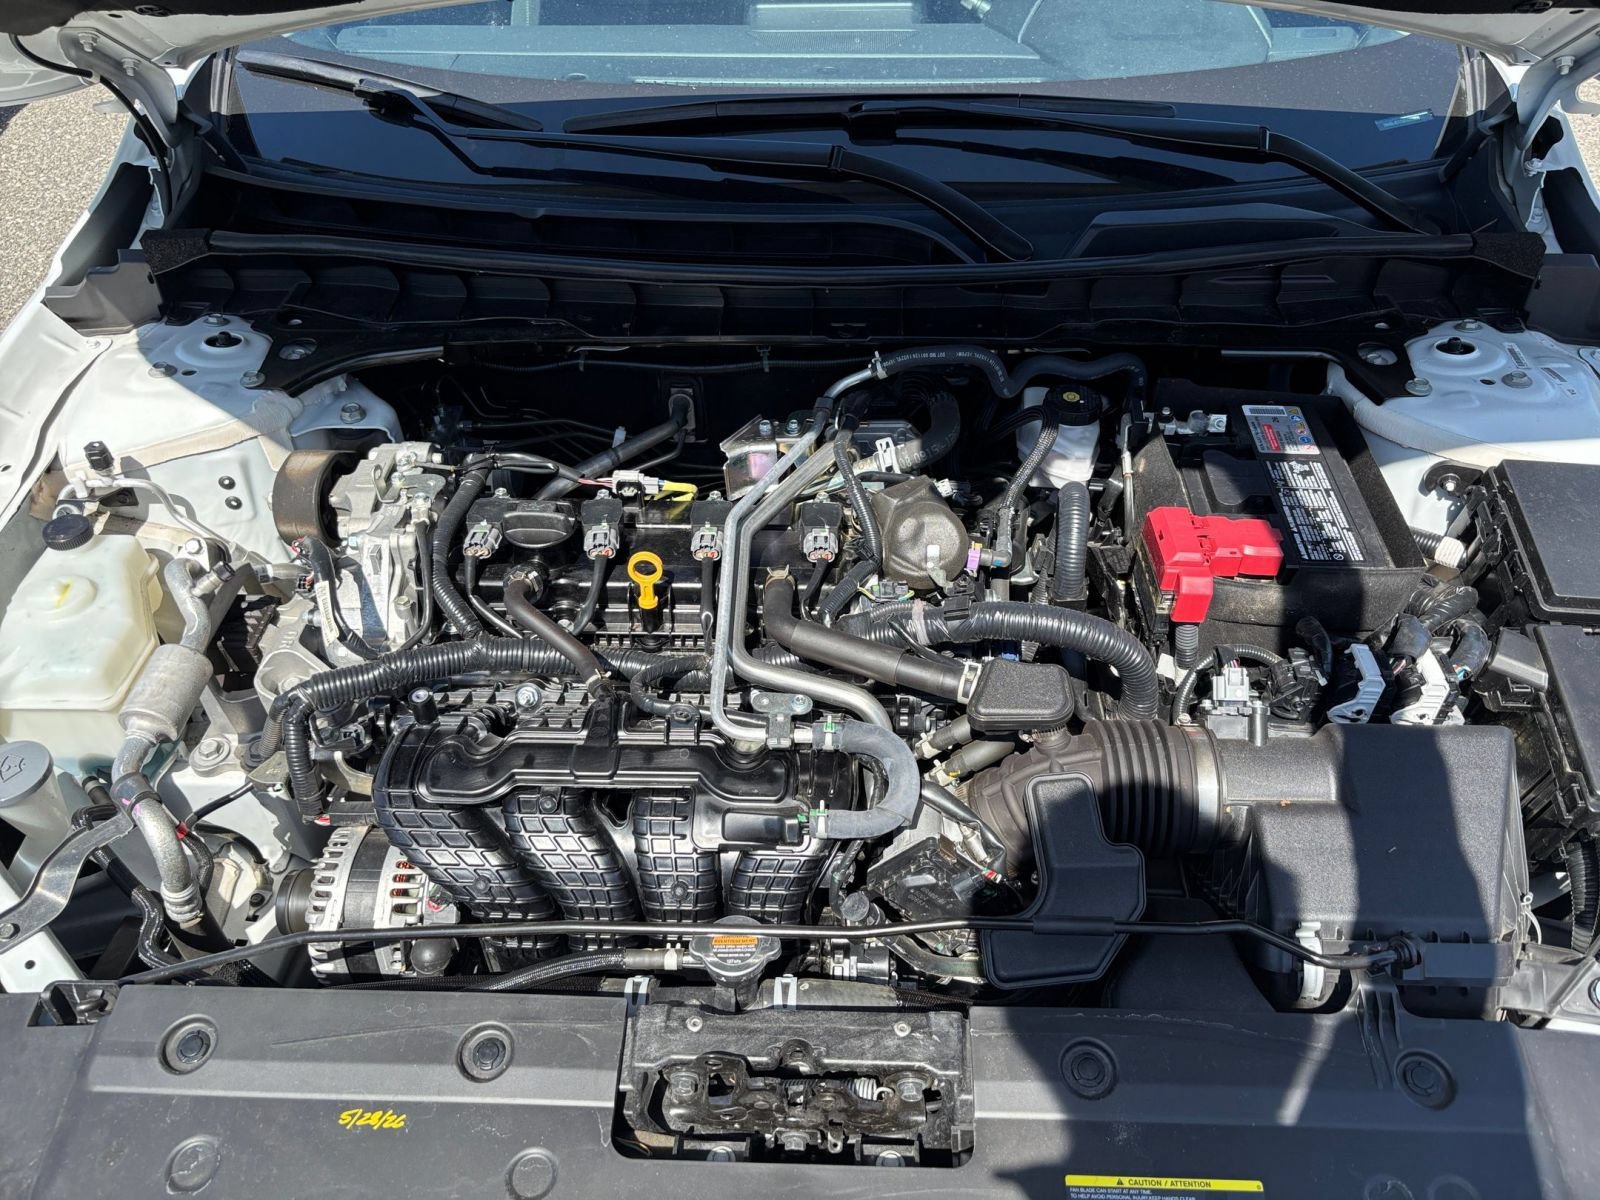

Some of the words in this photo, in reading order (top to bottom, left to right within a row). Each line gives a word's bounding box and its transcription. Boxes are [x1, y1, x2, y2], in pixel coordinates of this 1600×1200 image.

[338, 1108, 407, 1130] 5/28/26
[1128, 1179, 1162, 1187] CAUTION
[1170, 1180, 1211, 1188] ATTENTION
